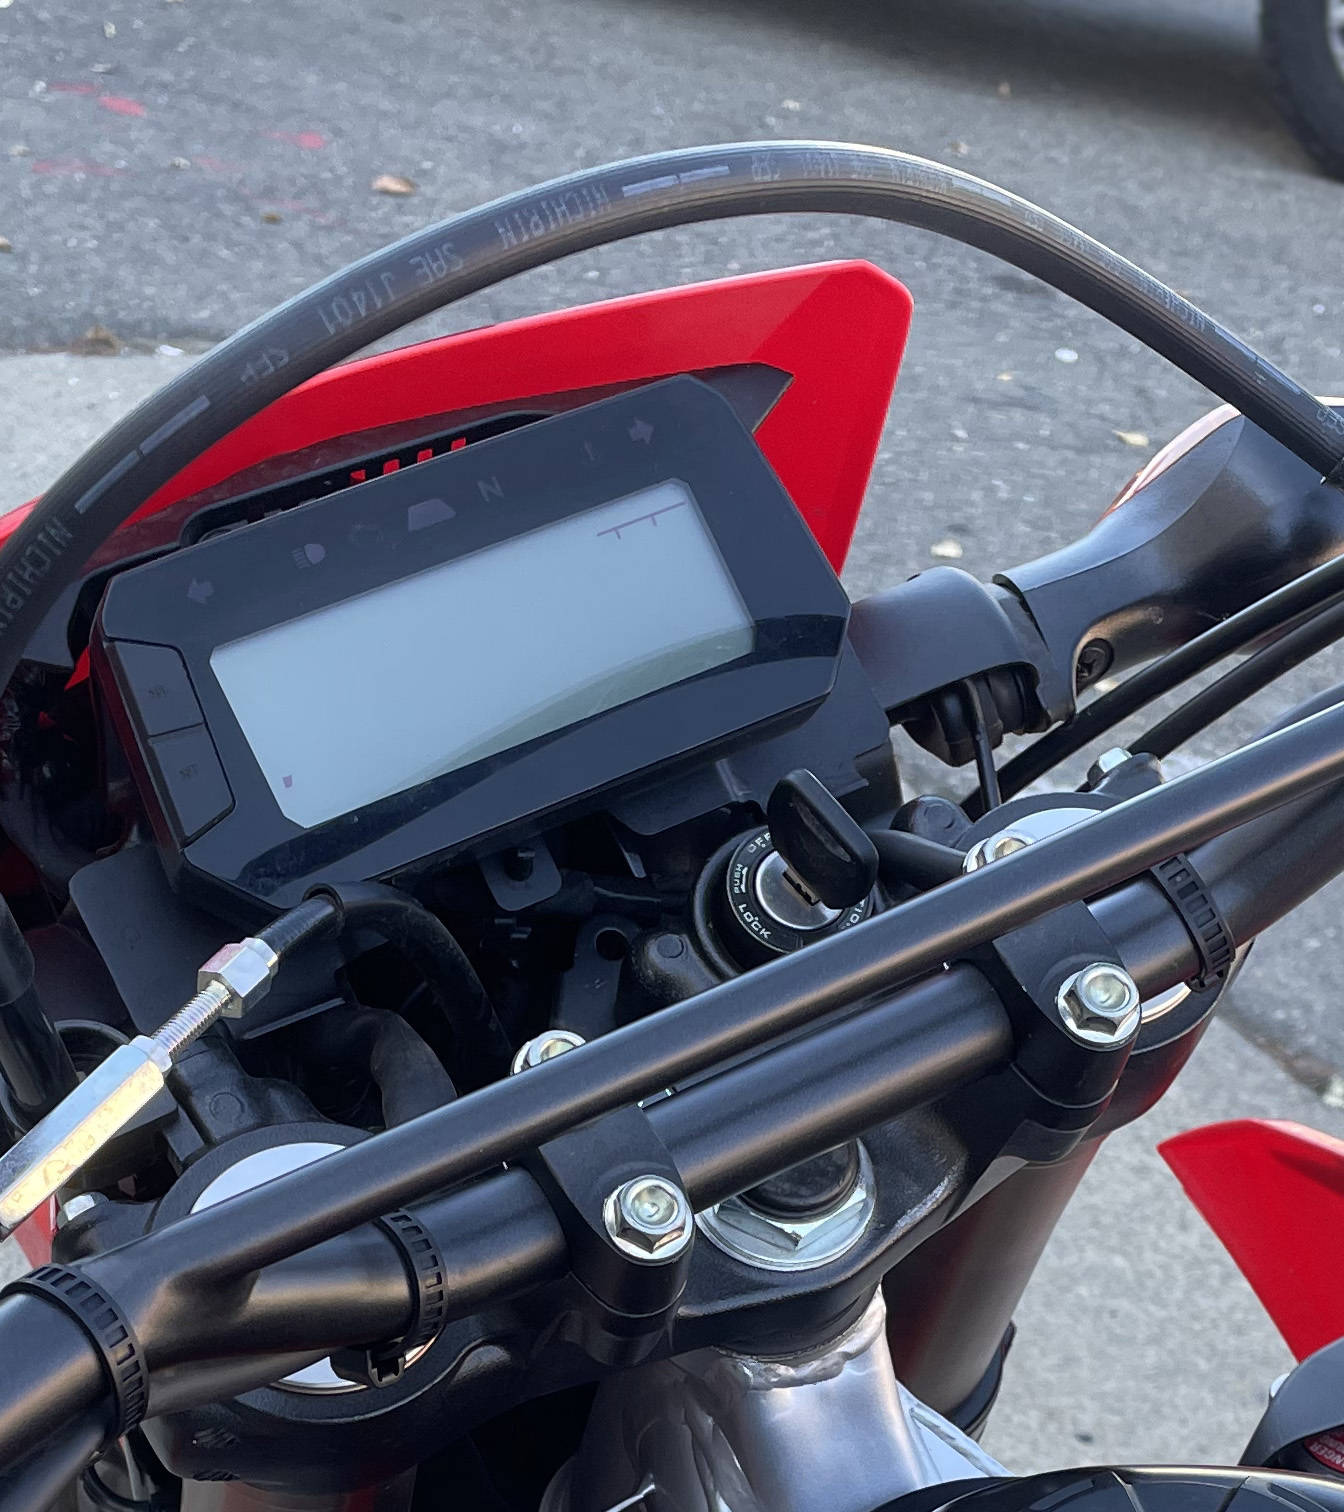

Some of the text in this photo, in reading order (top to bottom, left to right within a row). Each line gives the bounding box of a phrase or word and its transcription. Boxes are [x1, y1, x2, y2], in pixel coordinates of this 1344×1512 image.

[493, 184, 612, 251] NICHIRIN
[409, 242, 464, 286] SAE
[733, 863, 744, 894] PUSH
[738, 904, 772, 939] LOCK
